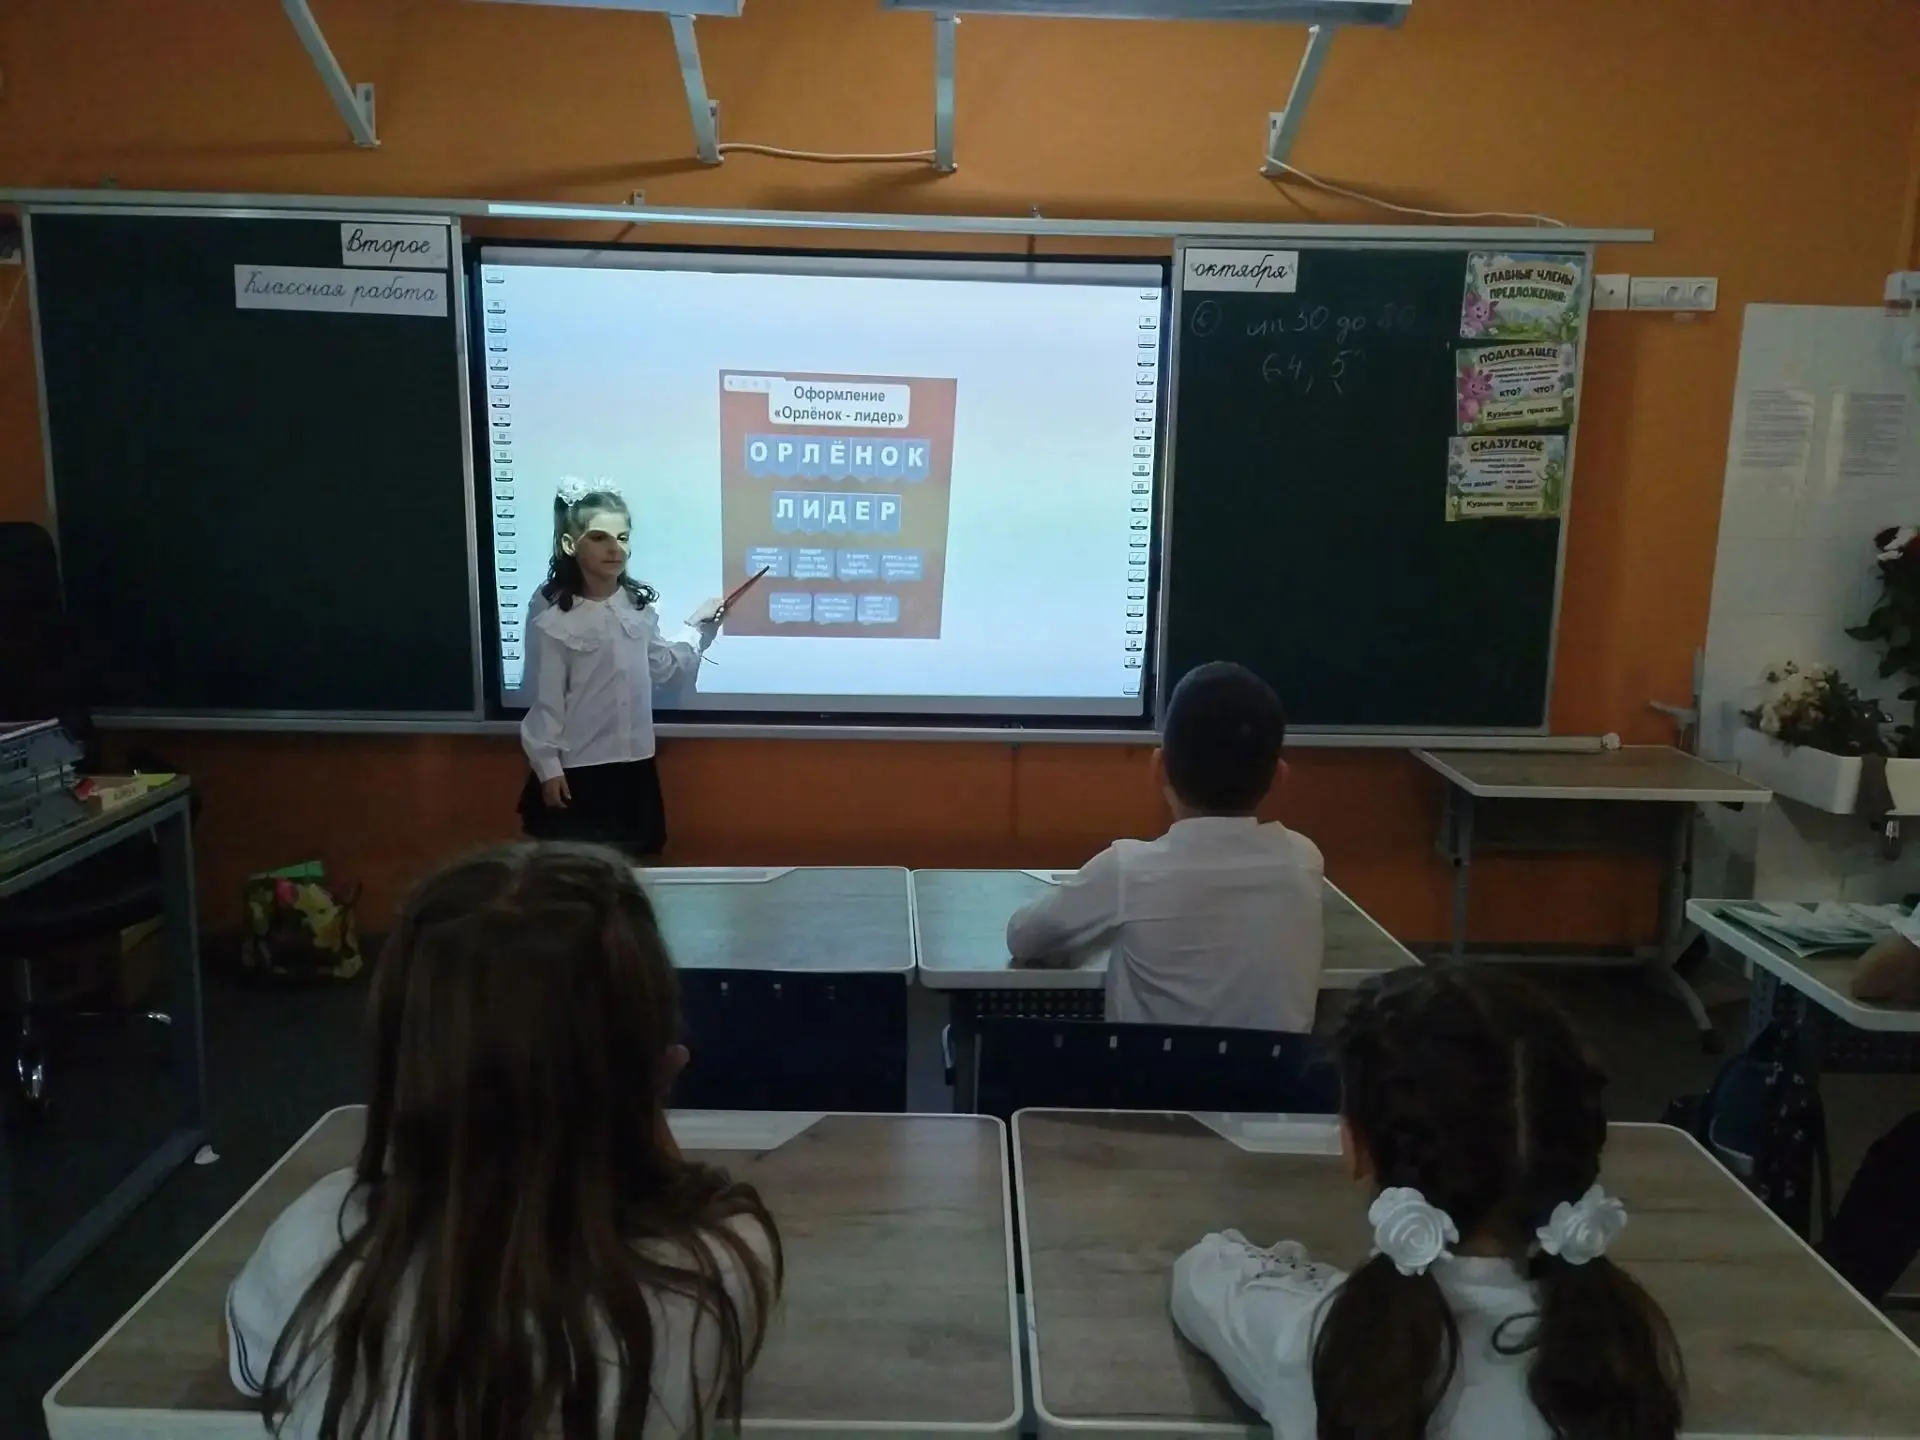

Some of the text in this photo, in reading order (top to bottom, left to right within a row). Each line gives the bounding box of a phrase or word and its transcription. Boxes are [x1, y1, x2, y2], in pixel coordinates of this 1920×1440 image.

[346, 228, 430, 264] Второе
[1195, 254, 1288, 288] октября
[1484, 268, 1575, 285] ГЛАВНЫЕ ЧЛЕНЫ
[244, 271, 438, 307] Классная работа
[1480, 347, 1558, 364] ПОДЛЕЖАЩЕЕ
[794, 385, 885, 404] Оформление
[1533, 384, 1555, 394] ЧТО?
[774, 405, 842, 422] «Орлёнок
[854, 410, 903, 424] лидер»
[750, 440, 924, 467] ОРЛЁНОК
[1471, 438, 1545, 452] СКАЗУЕМОЕ
[776, 498, 896, 524] ЛИДЕР
